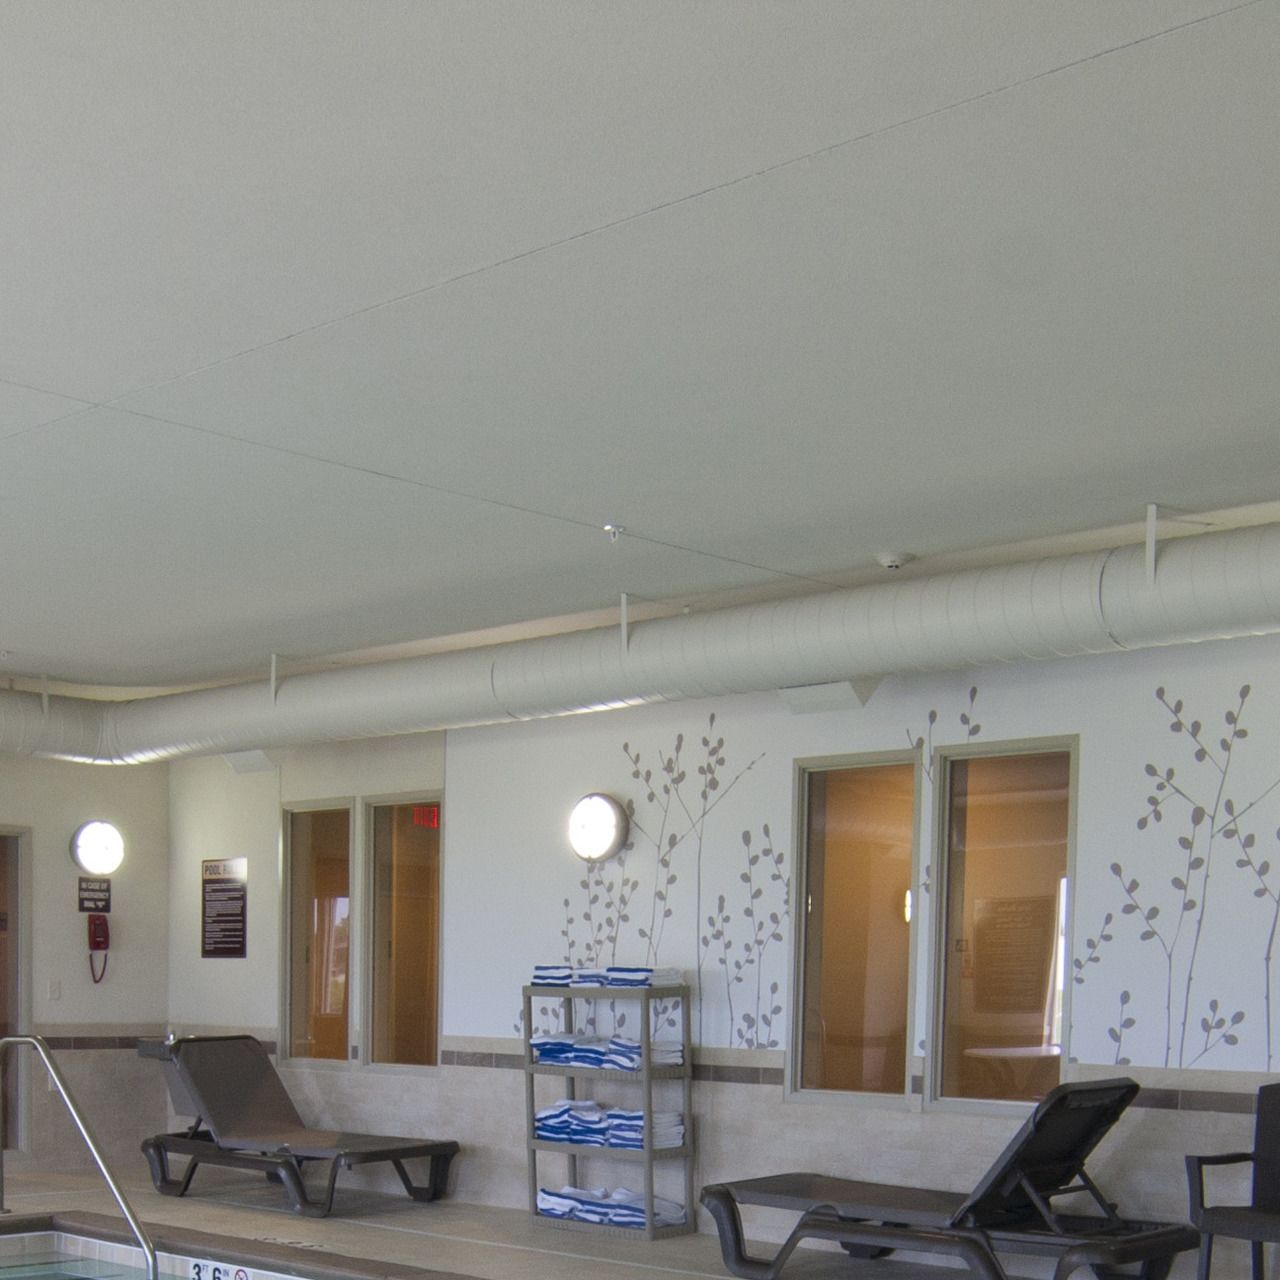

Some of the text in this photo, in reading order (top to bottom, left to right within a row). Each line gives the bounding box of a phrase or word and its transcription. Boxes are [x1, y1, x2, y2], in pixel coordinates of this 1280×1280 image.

[204, 863, 222, 876] POOL
[202, 1264, 209, 1273] FT
[222, 1268, 230, 1277] IN
